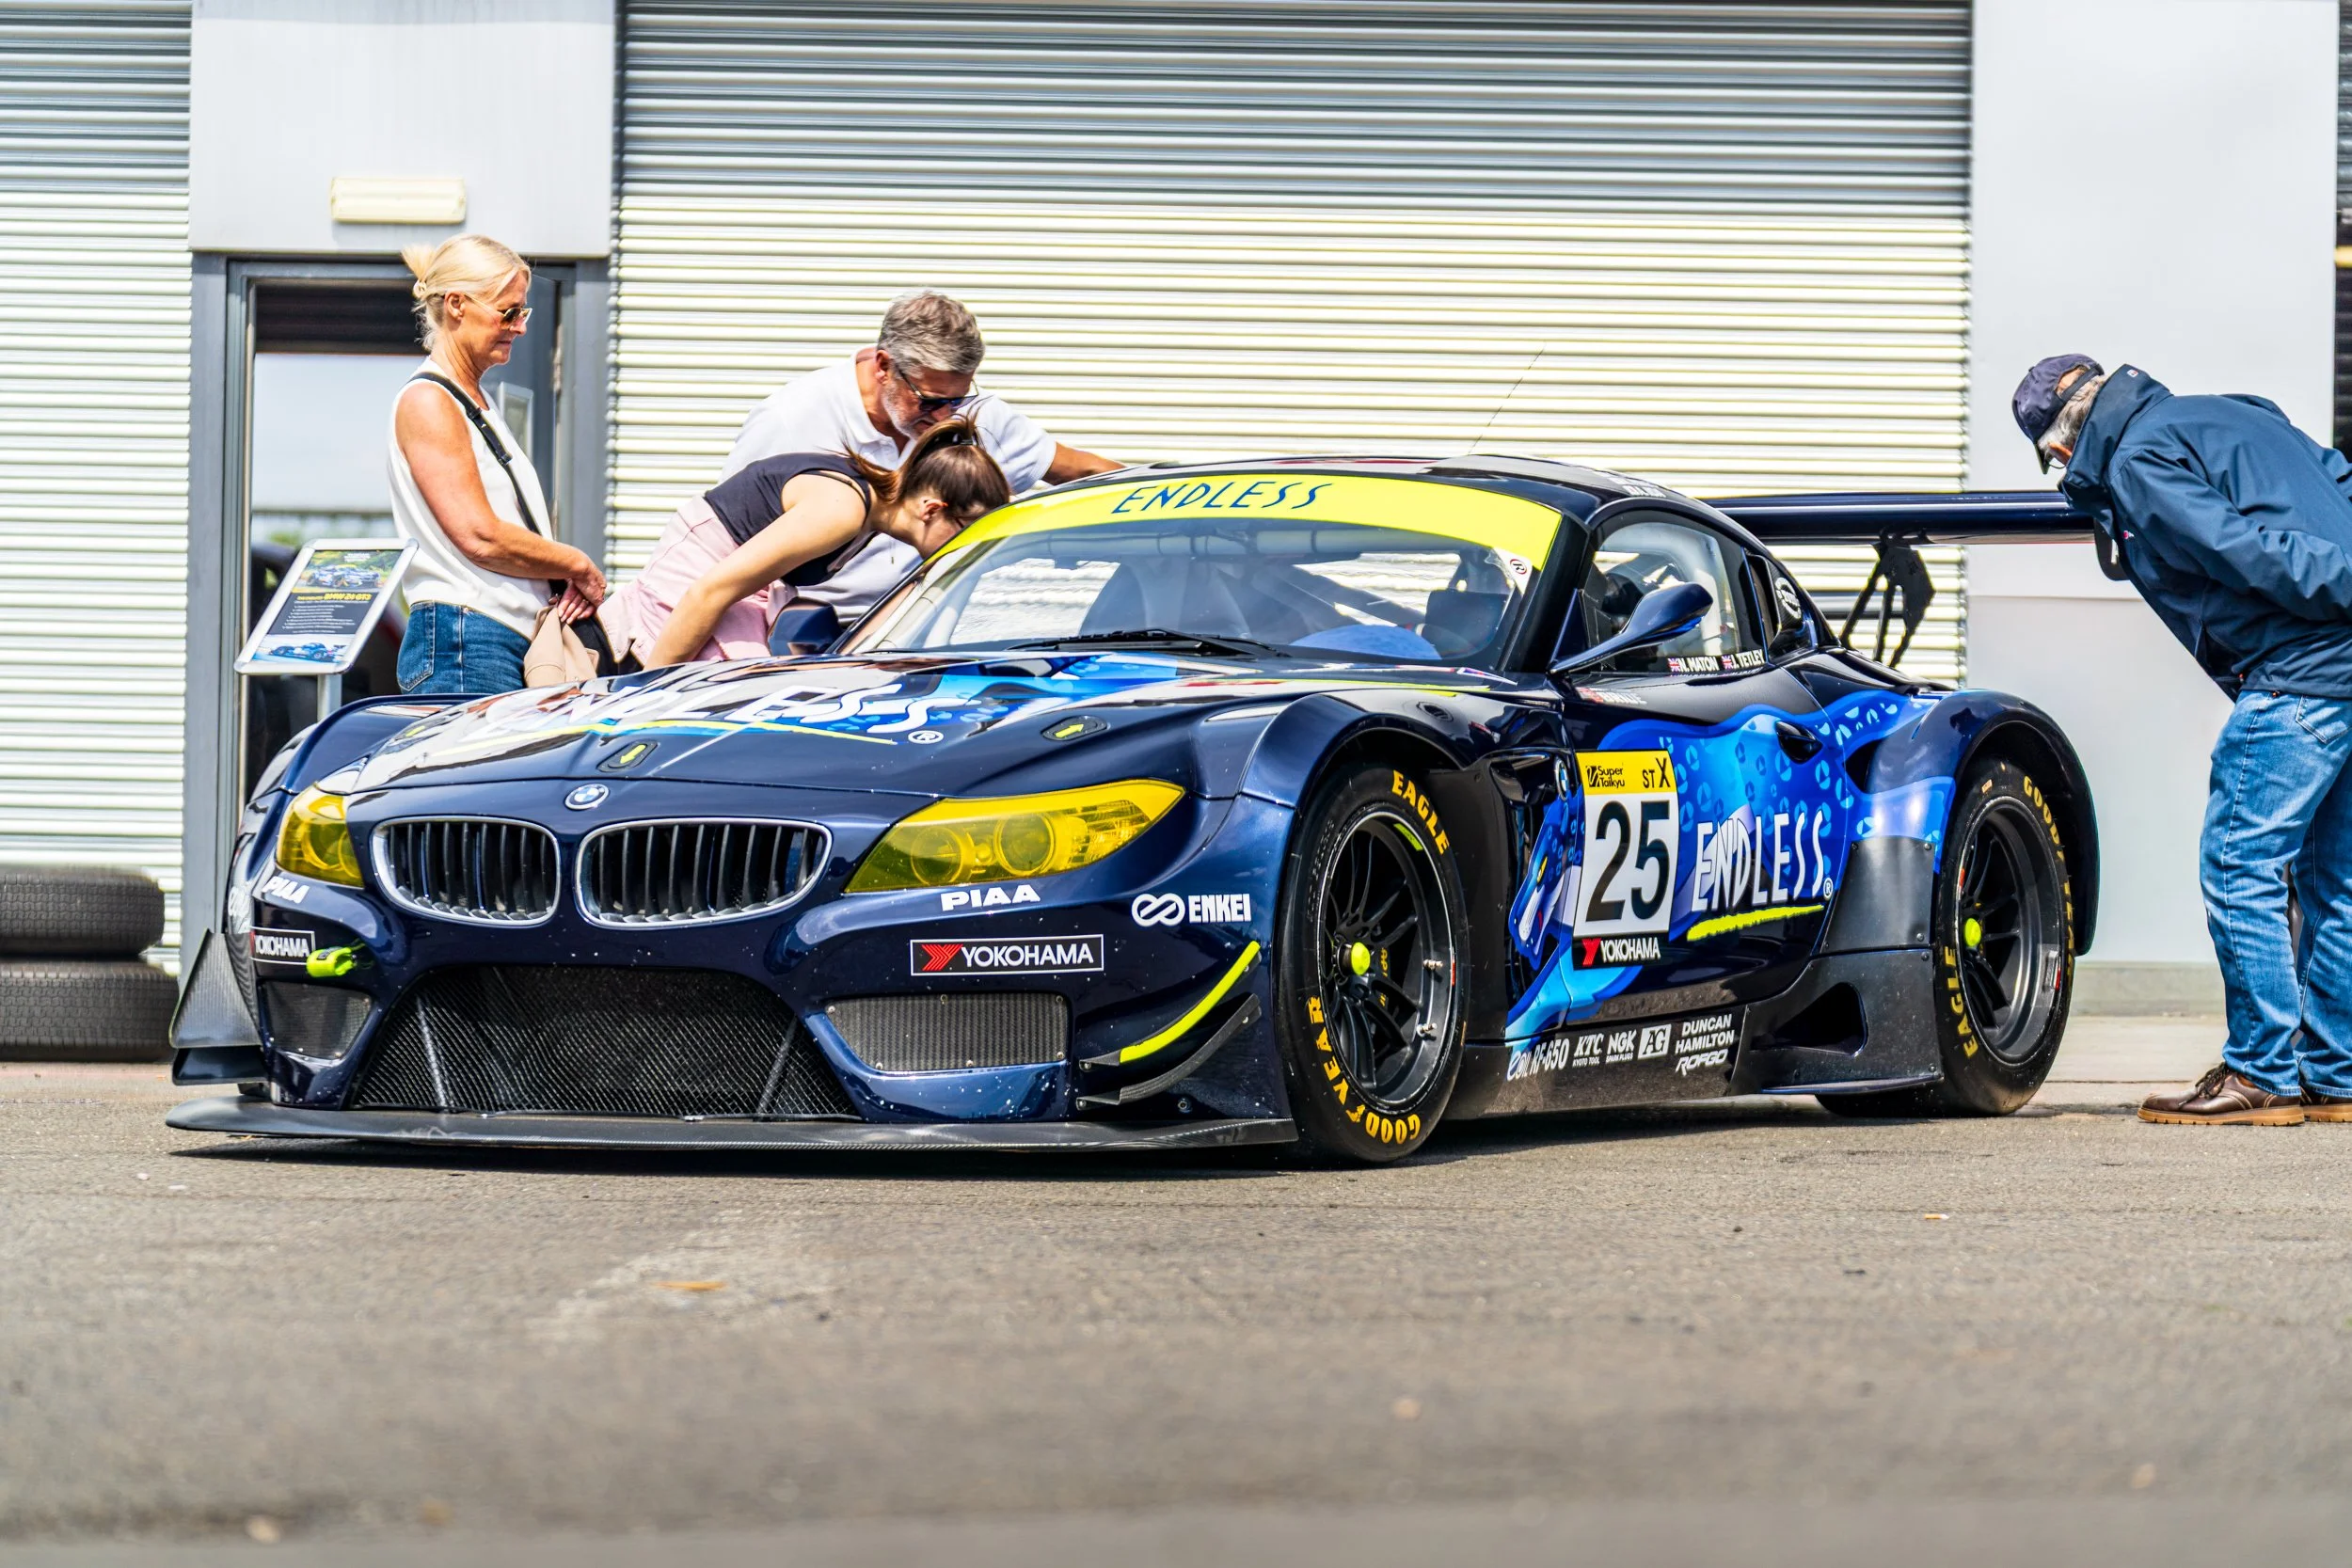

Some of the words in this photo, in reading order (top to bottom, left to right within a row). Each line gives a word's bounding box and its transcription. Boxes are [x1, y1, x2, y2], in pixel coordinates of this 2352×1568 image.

[1110, 481, 1334, 514] ENDLESS
[1687, 656, 1720, 672] MATON
[1736, 649, 1765, 668] TETLEY
[1597, 765, 1624, 777] Super
[1598, 777, 1626, 788] Taikyu
[1642, 768, 1655, 788] ST
[1656, 757, 1671, 788] X
[1392, 769, 1450, 855] EAGLE
[1585, 800, 1670, 923] 25
[1691, 810, 1823, 912] ENDLESS
[262, 876, 310, 904] PIAA
[941, 884, 1041, 911] PIAA
[1188, 894, 1252, 924] ENKEI
[961, 942, 1094, 968] YOKOHAMA
[1600, 937, 1661, 962] YOKOHAMA
[1945, 945, 1979, 1058] EAGLE
[1681, 1013, 1732, 1037] DUNCAN
[1573, 1033, 1604, 1057] KTC
[1607, 1029, 1637, 1054] NGK
[1675, 1029, 1735, 1054] HAMILTON
[1530, 1037, 1570, 1075] RF-650
[1675, 1048, 1729, 1076] ROFGO
